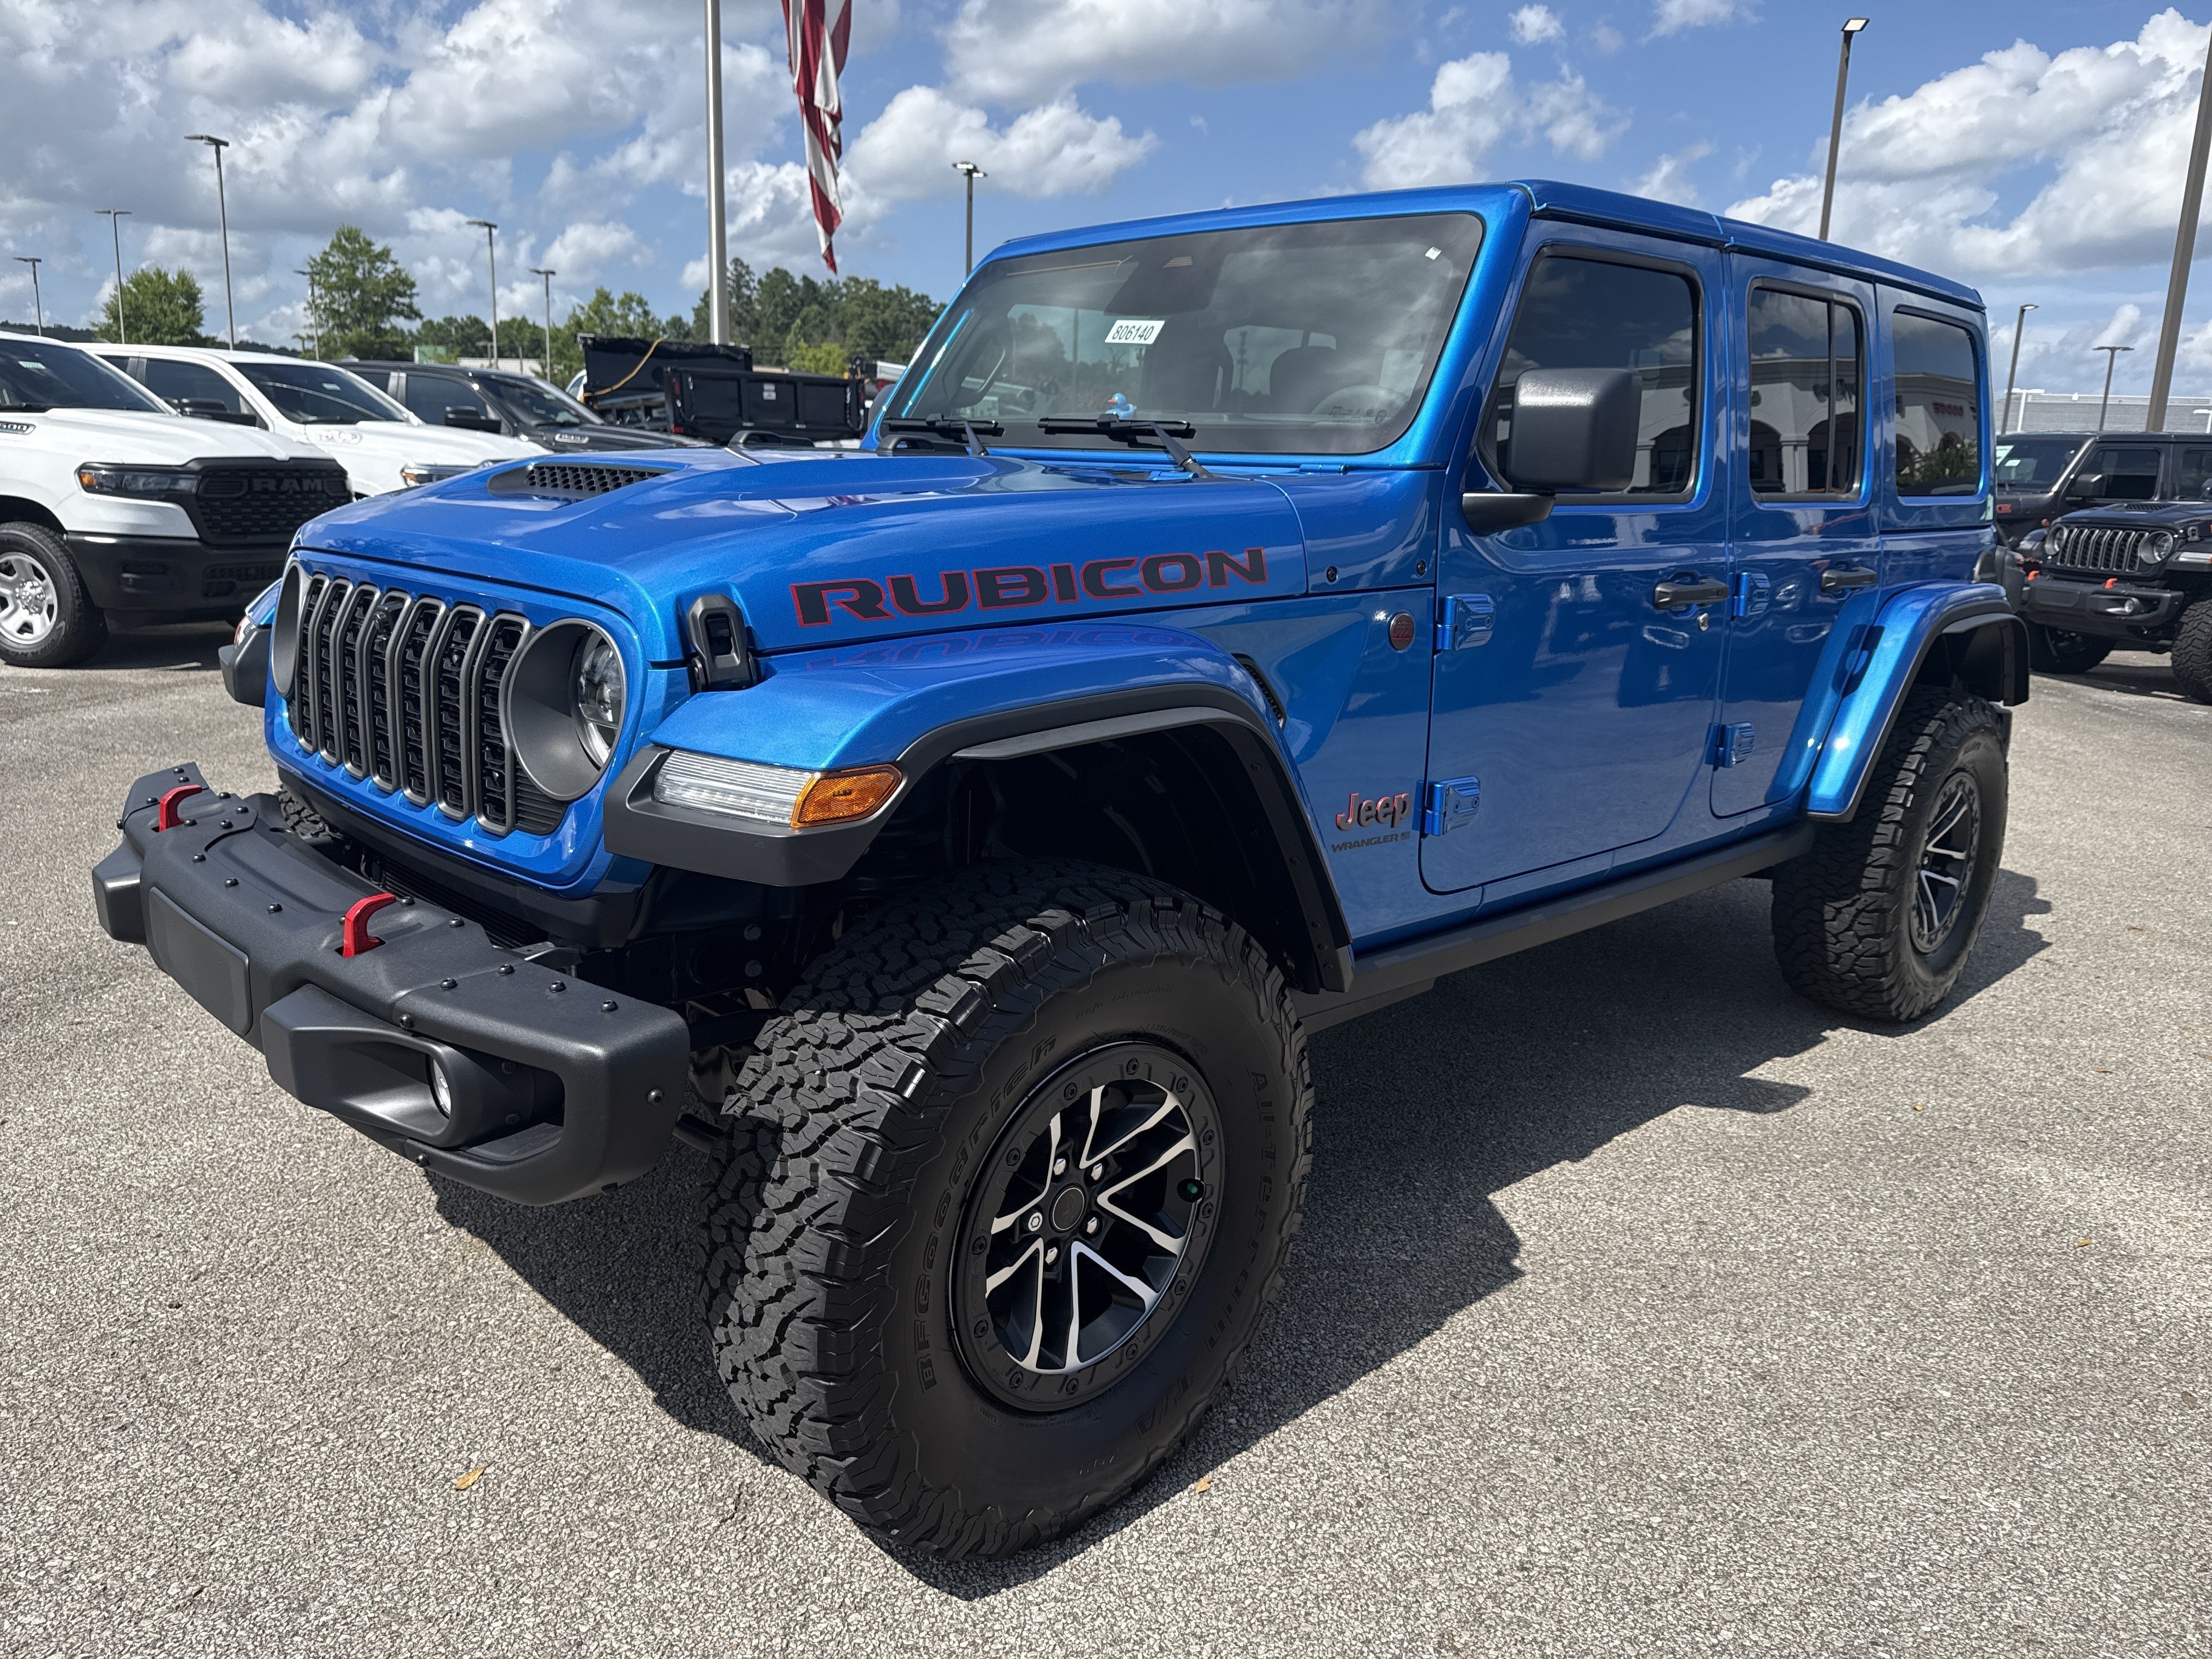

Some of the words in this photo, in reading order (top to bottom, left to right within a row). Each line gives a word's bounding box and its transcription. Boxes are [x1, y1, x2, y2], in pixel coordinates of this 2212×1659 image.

[1111, 325, 1154, 341] 806140
[252, 478, 323, 492] RAM
[789, 547, 1268, 628] RUBICON
[1335, 792, 1412, 831] Jeep
[1331, 833, 1398, 853] WRANGLER
[913, 1034, 1058, 1395] BFGoodrich
[1205, 1067, 1276, 1353] All-Terrain
